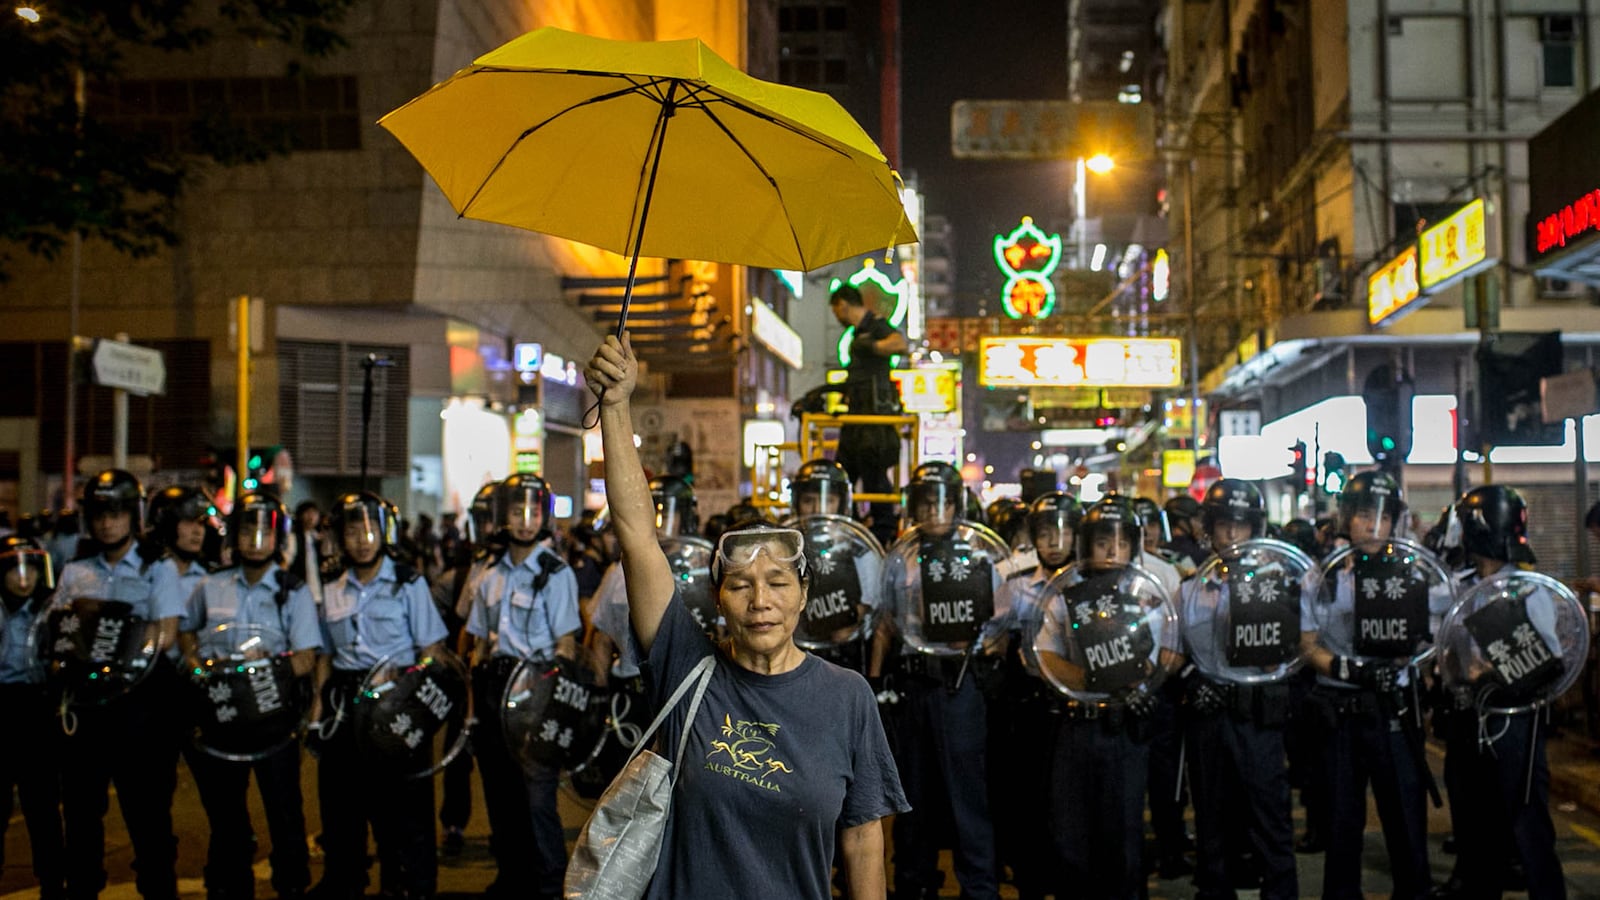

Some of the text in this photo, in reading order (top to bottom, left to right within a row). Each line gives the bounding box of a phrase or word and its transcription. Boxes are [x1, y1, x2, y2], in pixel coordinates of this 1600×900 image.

[1237, 579, 1280, 604] 警察
[1361, 576, 1407, 600] 警察
[806, 589, 850, 621] POLICE
[929, 600, 975, 625] POLICE
[1075, 595, 1119, 625] 警察
[90, 617, 124, 661] POLICE
[1235, 622, 1281, 648] POLICE
[1361, 618, 1407, 640] POLICE
[1085, 636, 1134, 671] POLICE
[1497, 640, 1552, 685] POLICE
[416, 677, 453, 720] POLICE
[554, 676, 590, 711] POLICE
[704, 761, 781, 793] AUSTRALIA
